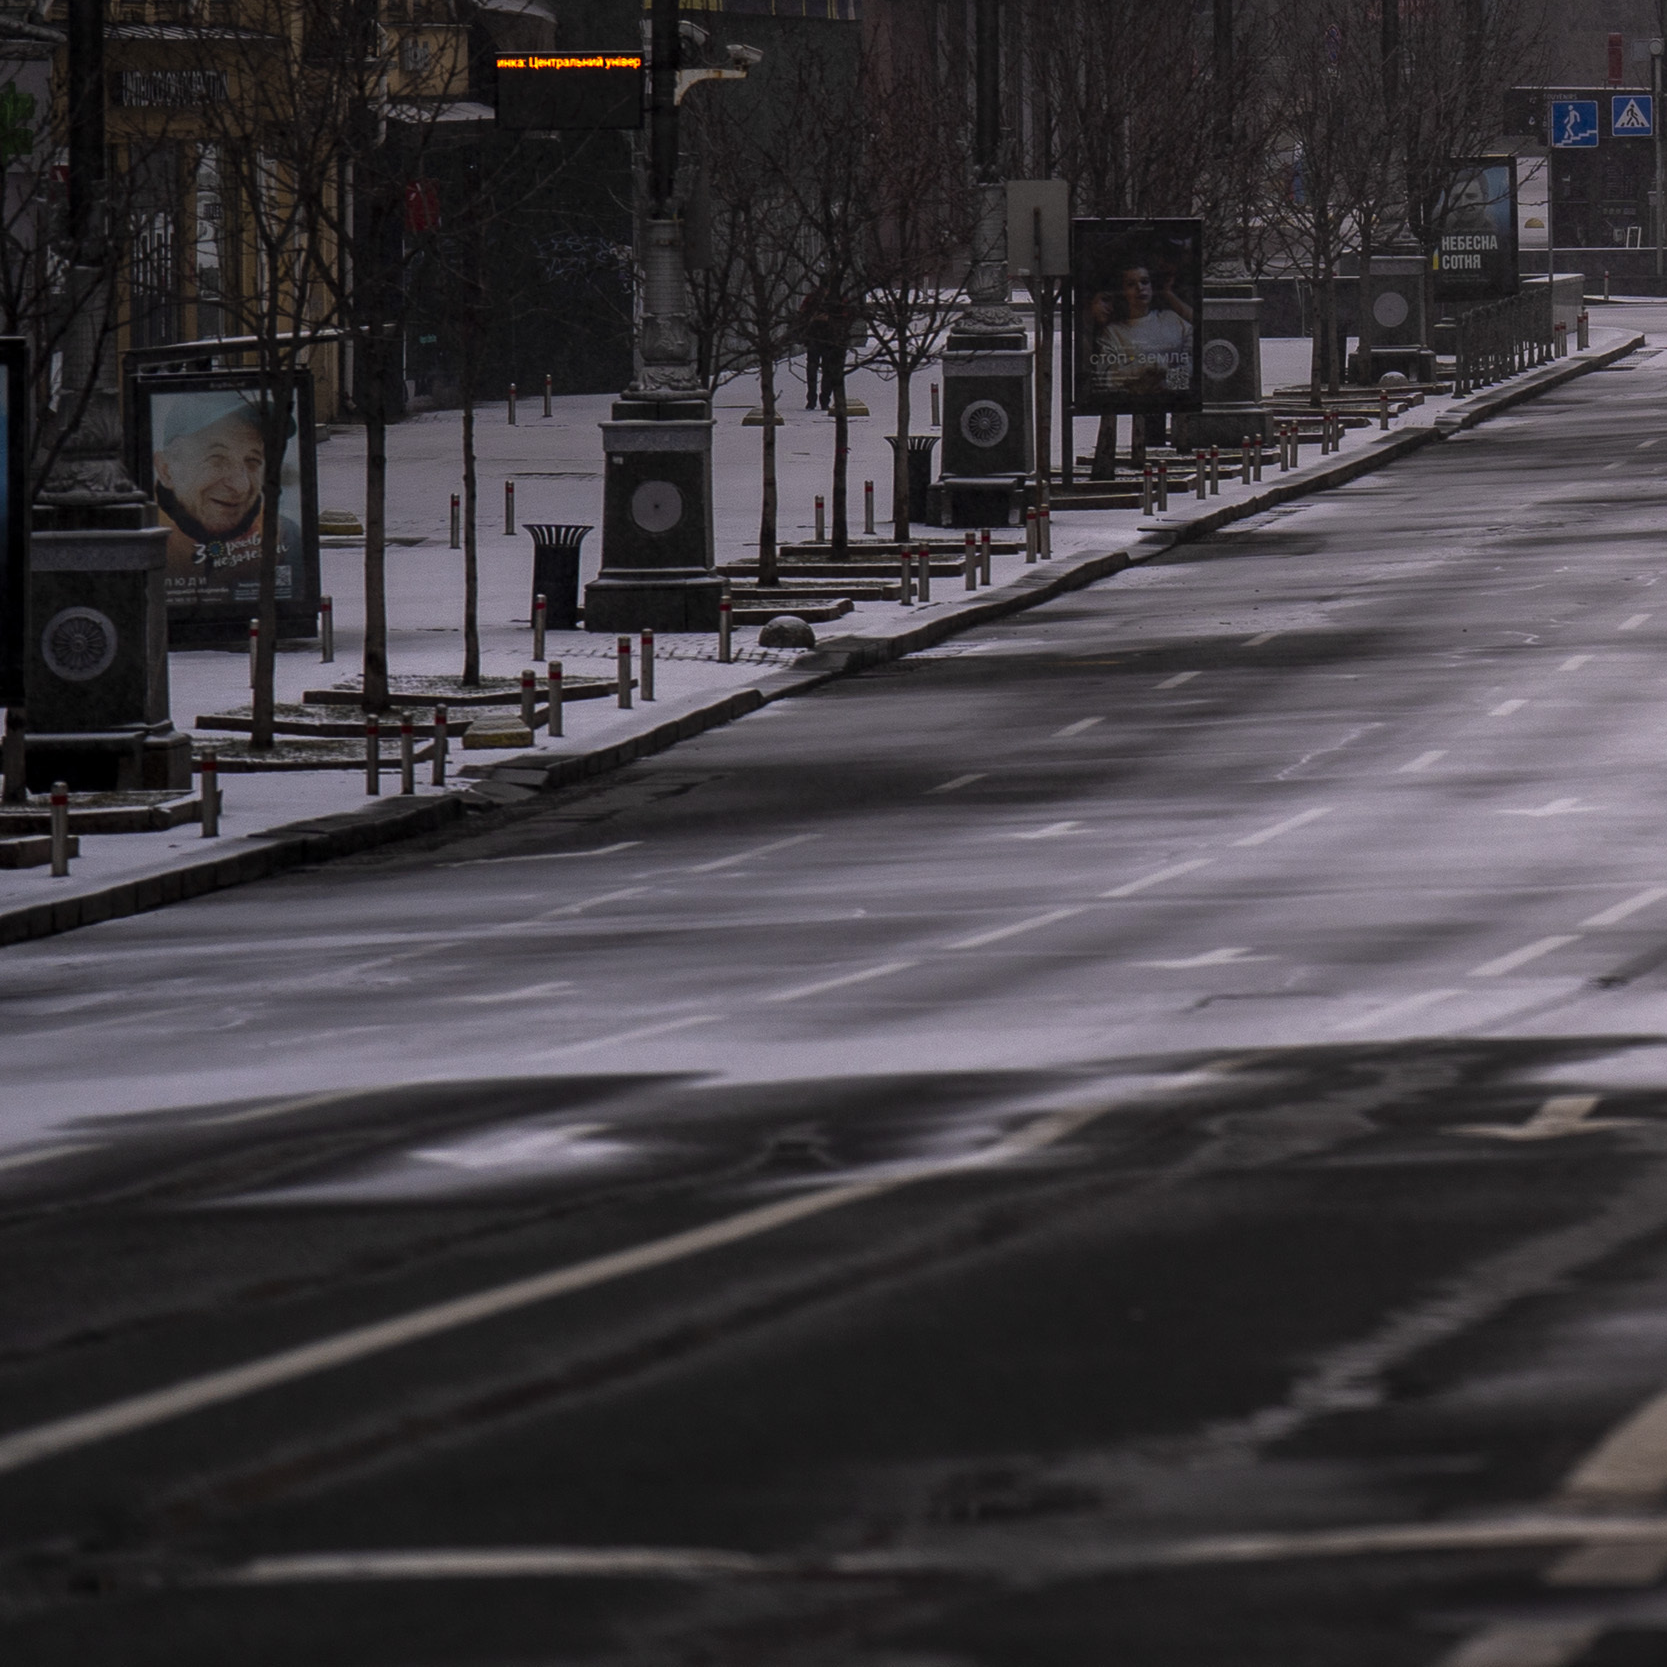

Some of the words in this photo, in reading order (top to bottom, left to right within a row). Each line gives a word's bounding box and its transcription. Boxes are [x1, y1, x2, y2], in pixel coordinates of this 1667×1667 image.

[529, 56, 603, 69] Центральний
[1442, 235, 1498, 251] НЕБЕСНА
[1442, 254, 1481, 270] СОТНЯ
